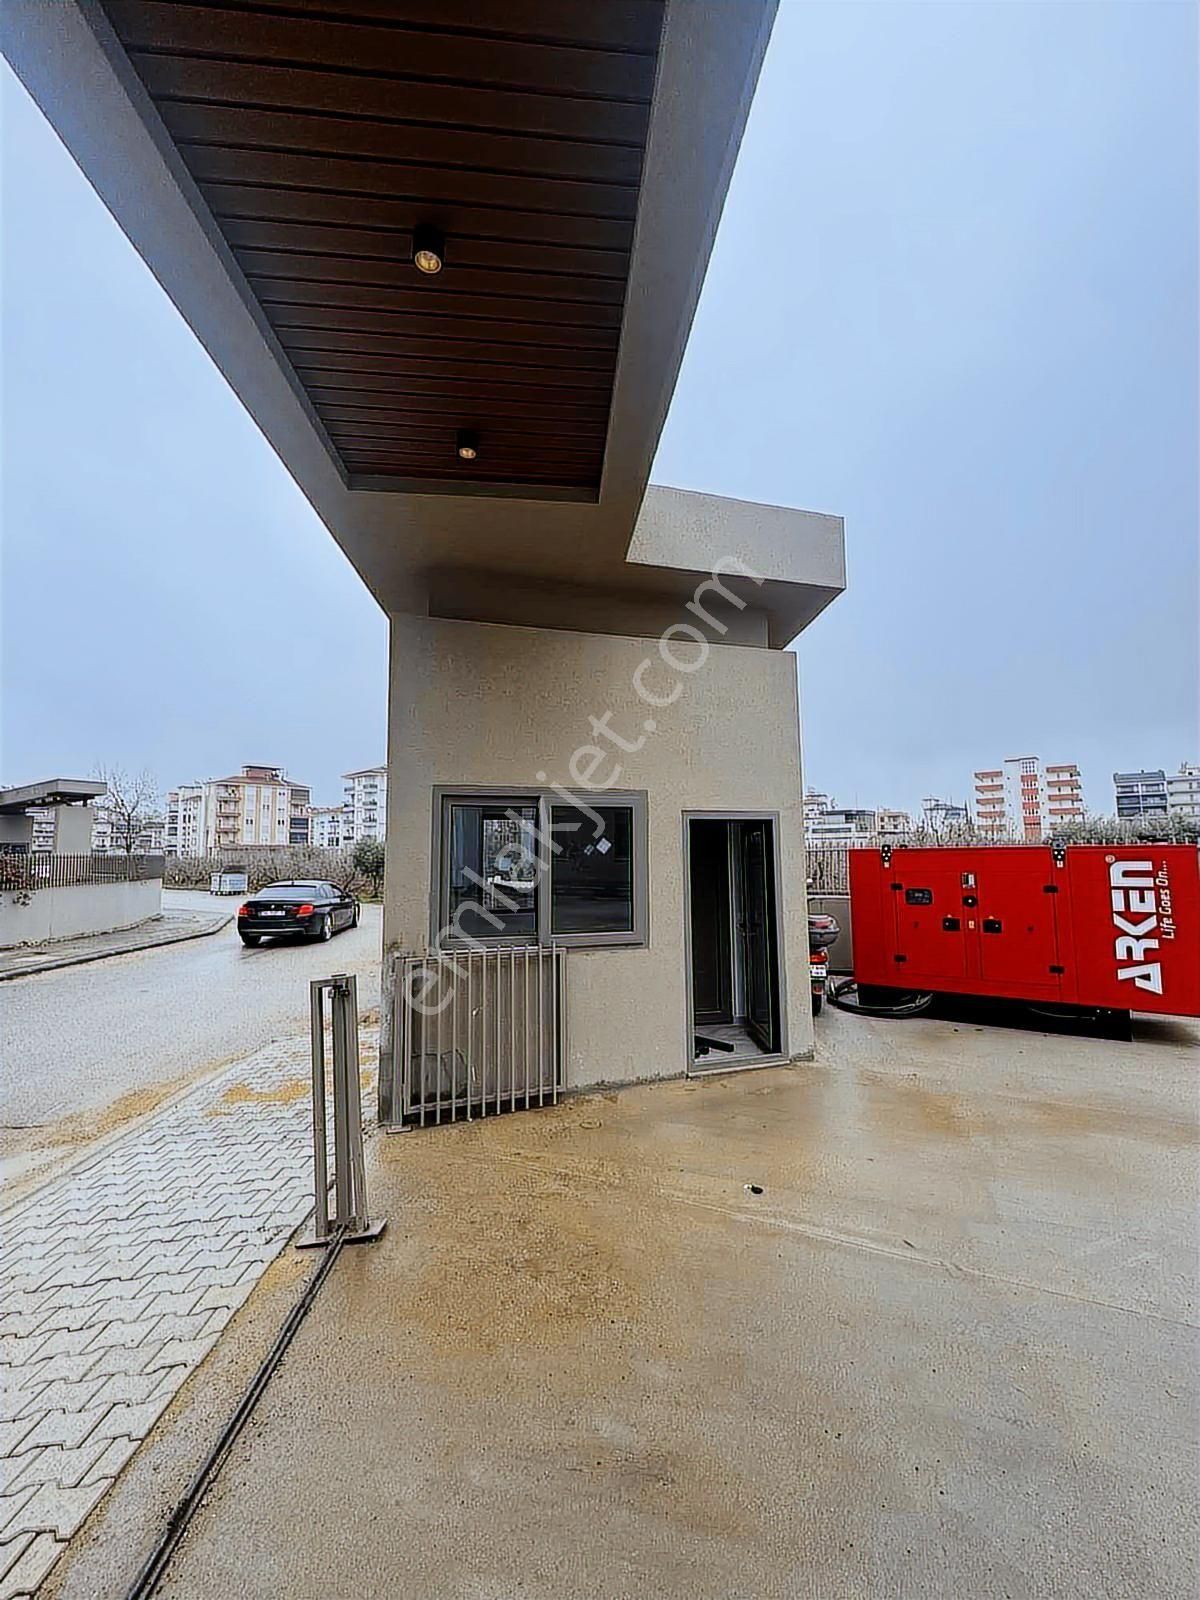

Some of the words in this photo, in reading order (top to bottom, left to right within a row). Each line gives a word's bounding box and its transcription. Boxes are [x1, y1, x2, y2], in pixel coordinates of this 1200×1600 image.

[1159, 889, 1172, 915] Goes
[1110, 861, 1163, 995] ARKEN
[1161, 917, 1176, 939] Life
